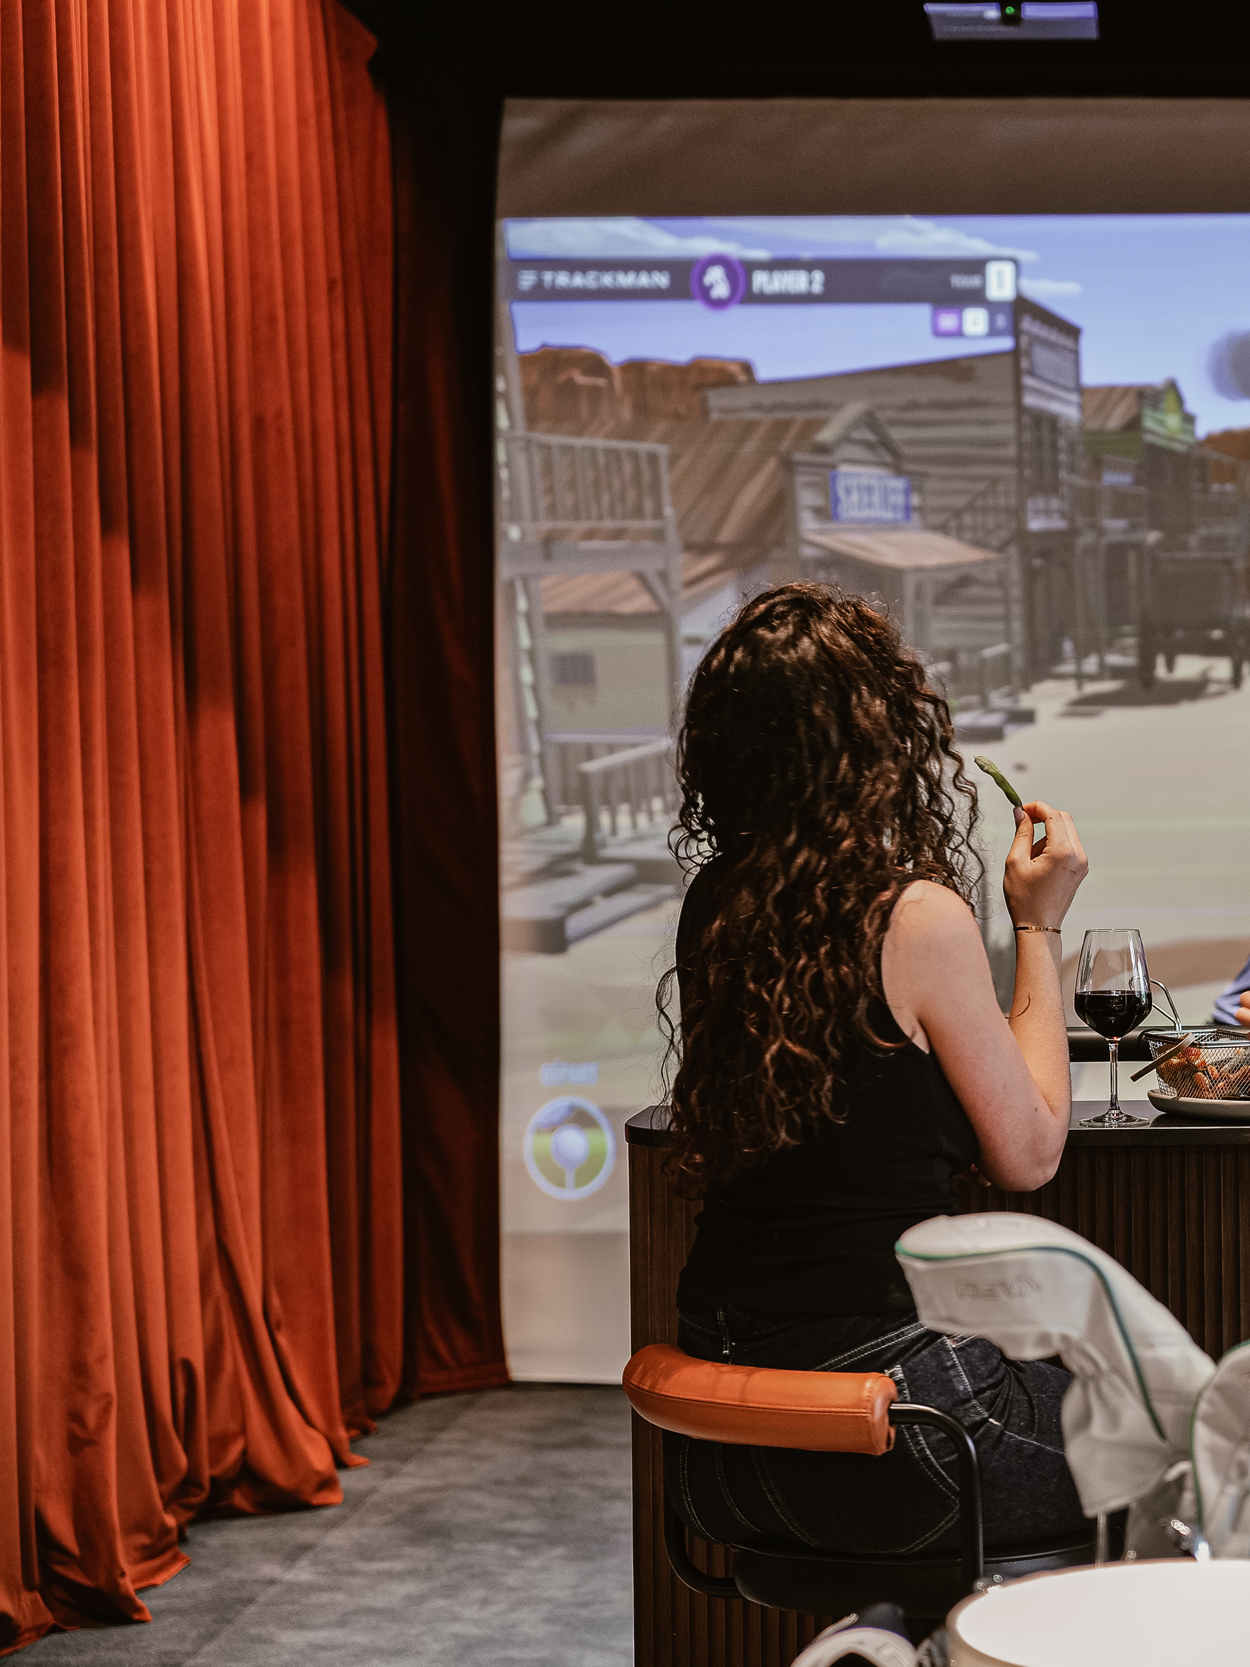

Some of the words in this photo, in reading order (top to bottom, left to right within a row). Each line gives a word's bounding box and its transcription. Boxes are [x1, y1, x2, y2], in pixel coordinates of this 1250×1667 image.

[541, 269, 670, 290] TRACKMAN
[752, 269, 809, 295] PLAYER
[810, 269, 825, 295] 2
